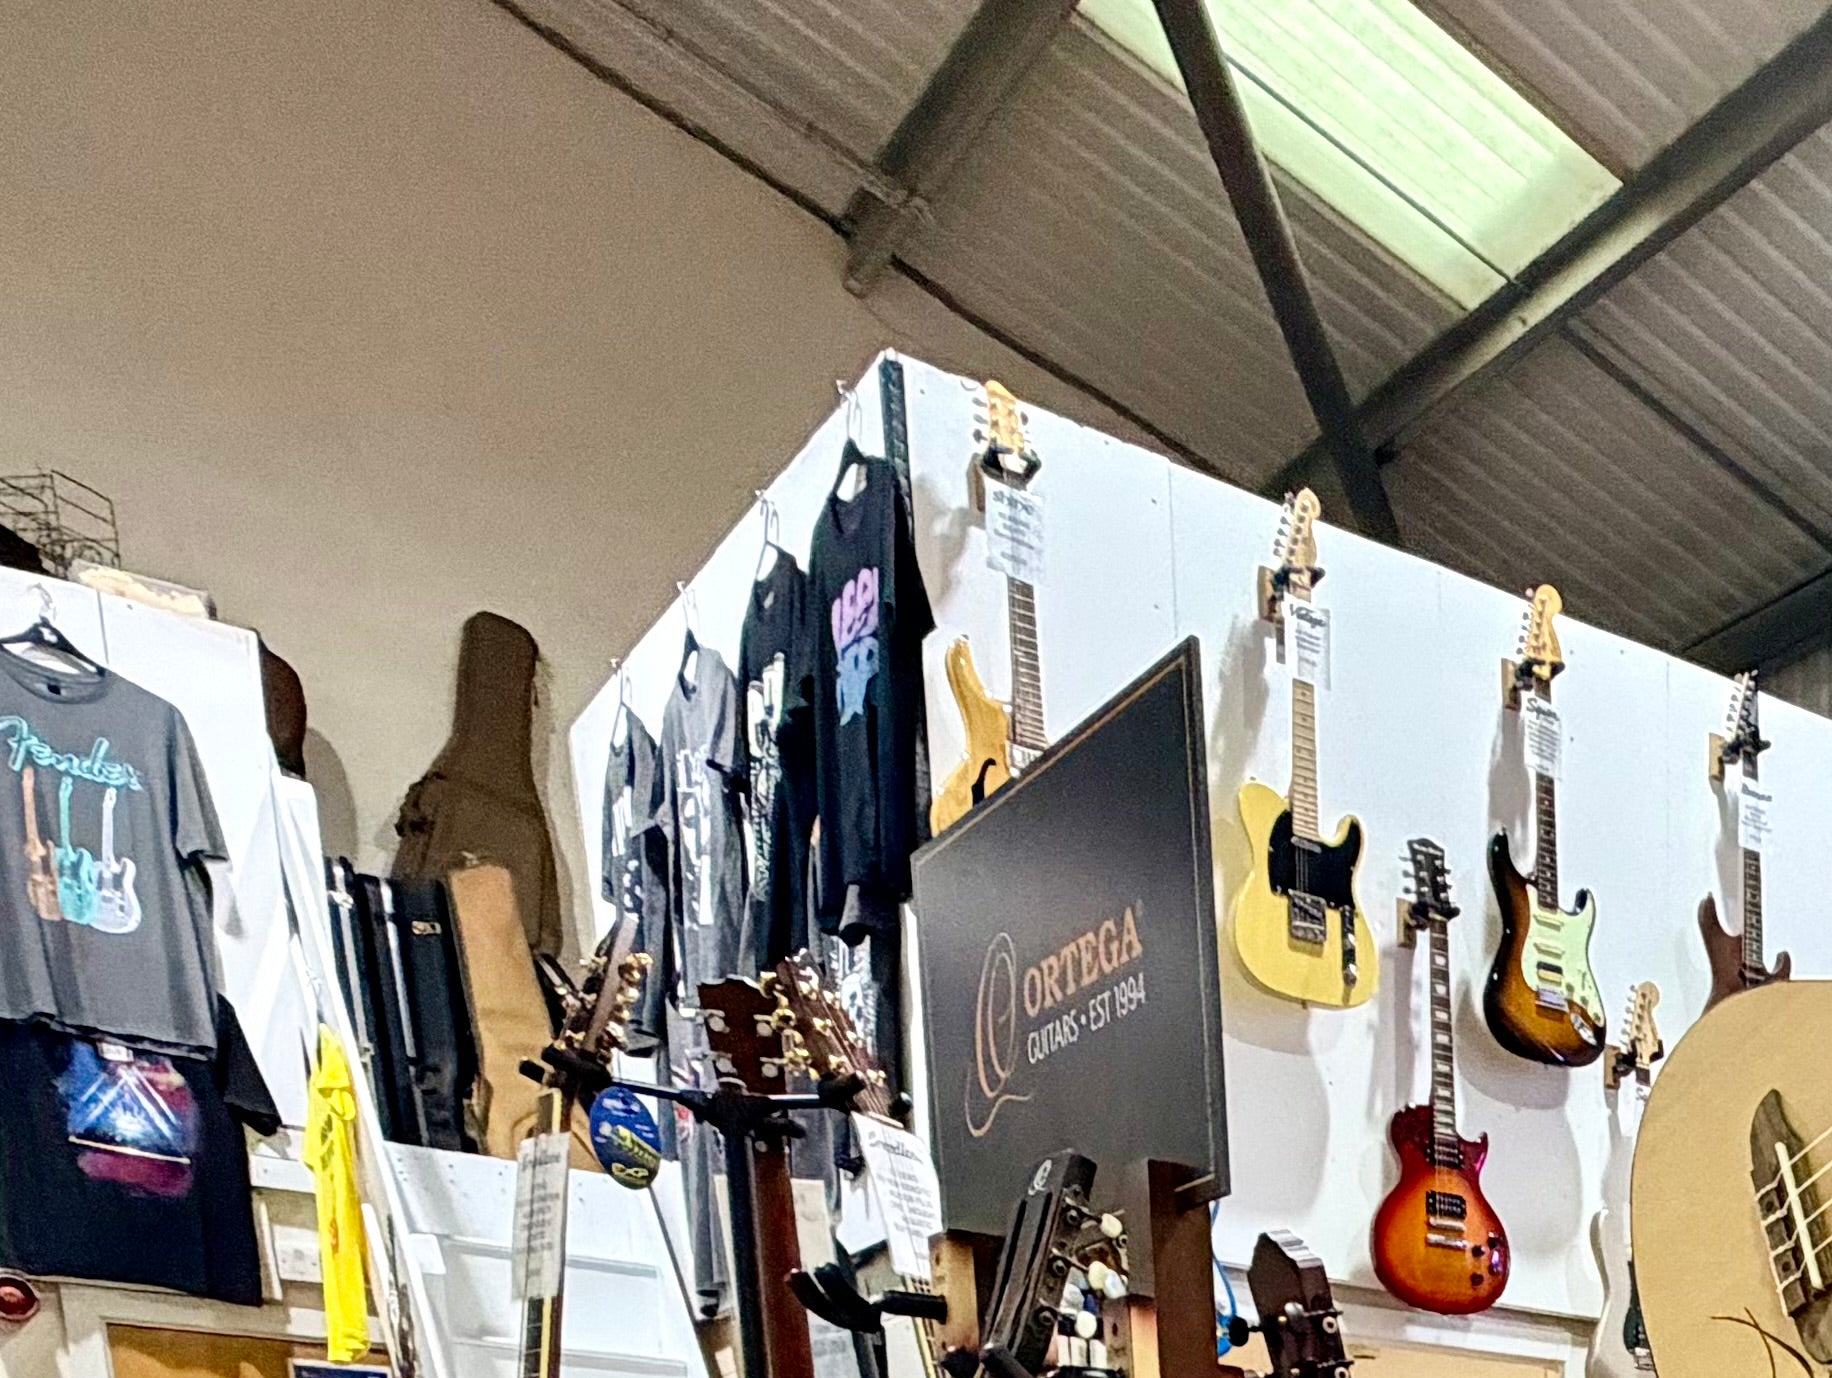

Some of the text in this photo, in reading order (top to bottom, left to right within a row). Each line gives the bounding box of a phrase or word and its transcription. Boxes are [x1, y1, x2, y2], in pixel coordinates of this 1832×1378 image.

[0, 715, 144, 792] Fender
[1023, 907, 1143, 1018] ORTEGA
[1027, 972, 1146, 1064] GUITARS EST 1994
